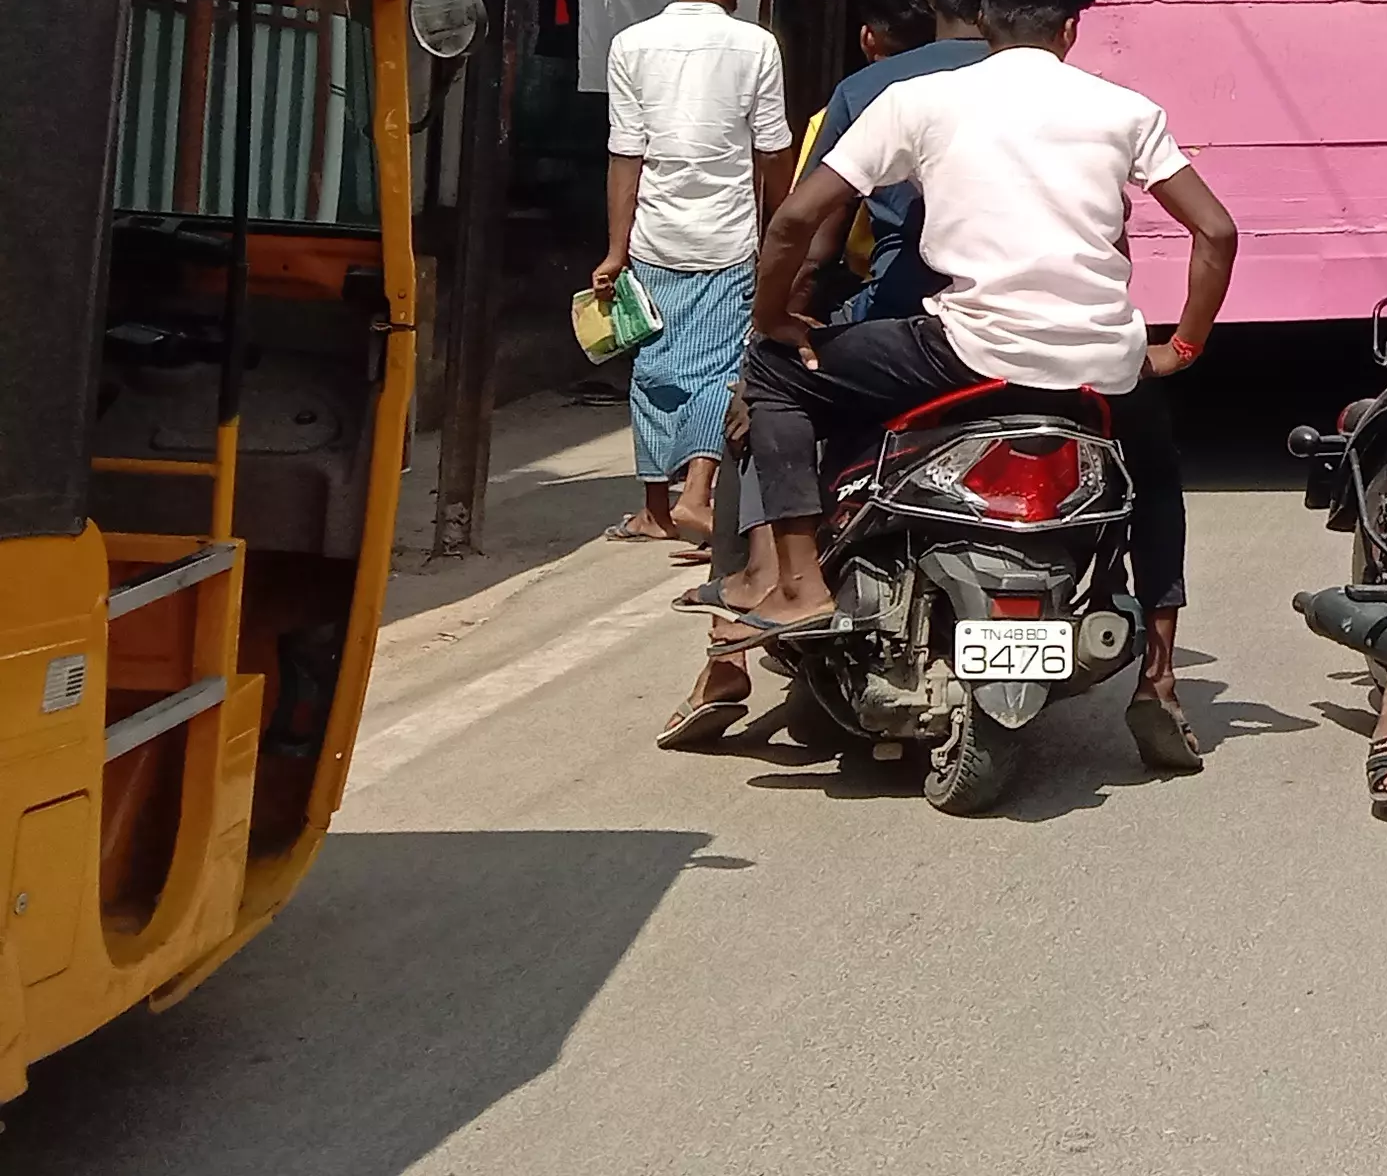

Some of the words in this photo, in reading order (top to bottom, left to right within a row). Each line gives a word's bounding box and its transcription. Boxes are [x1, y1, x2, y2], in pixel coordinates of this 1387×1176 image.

[980, 628, 1001, 641] TN
[1003, 628, 1024, 641] 48
[1026, 628, 1048, 641] BD
[961, 645, 1066, 674] 3476
